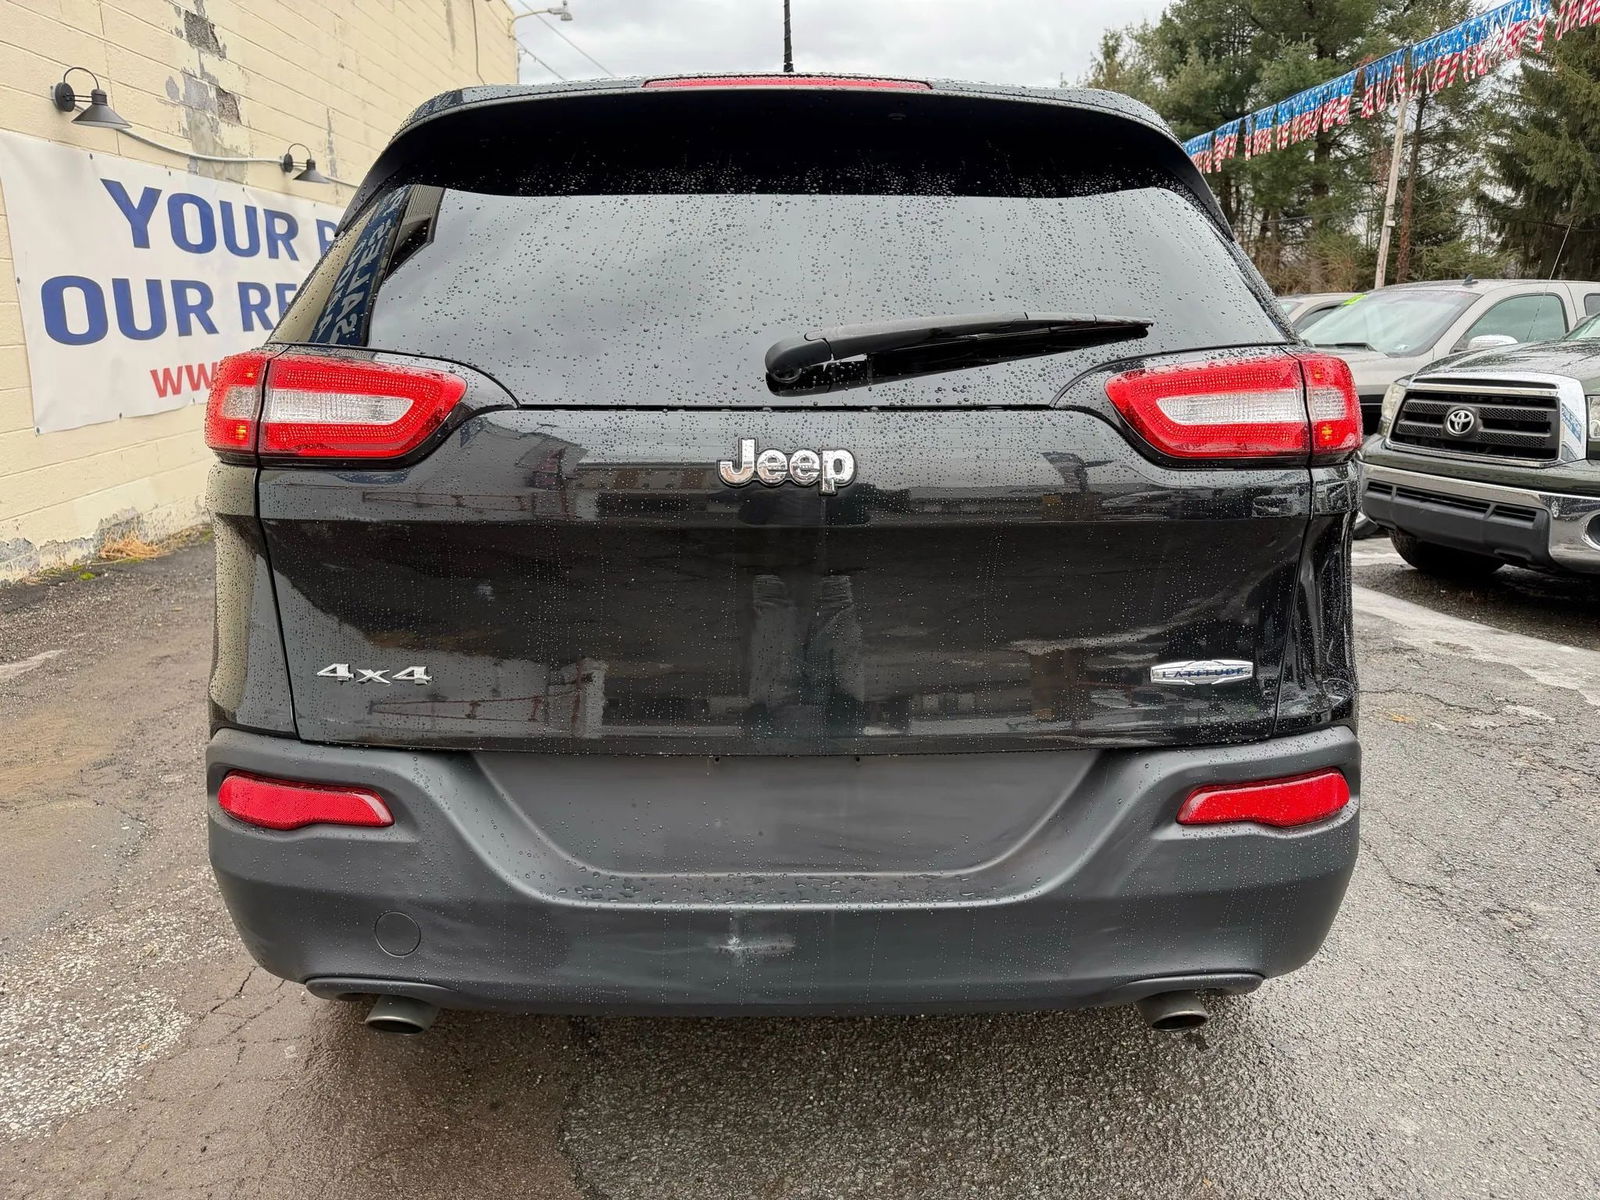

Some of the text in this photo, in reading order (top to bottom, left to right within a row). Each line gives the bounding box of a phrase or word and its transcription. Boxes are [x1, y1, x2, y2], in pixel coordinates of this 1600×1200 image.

[101, 178, 299, 261] YOUR
[41, 276, 219, 345] OUR
[718, 438, 856, 494] Jeep
[317, 663, 433, 685] 4x4
